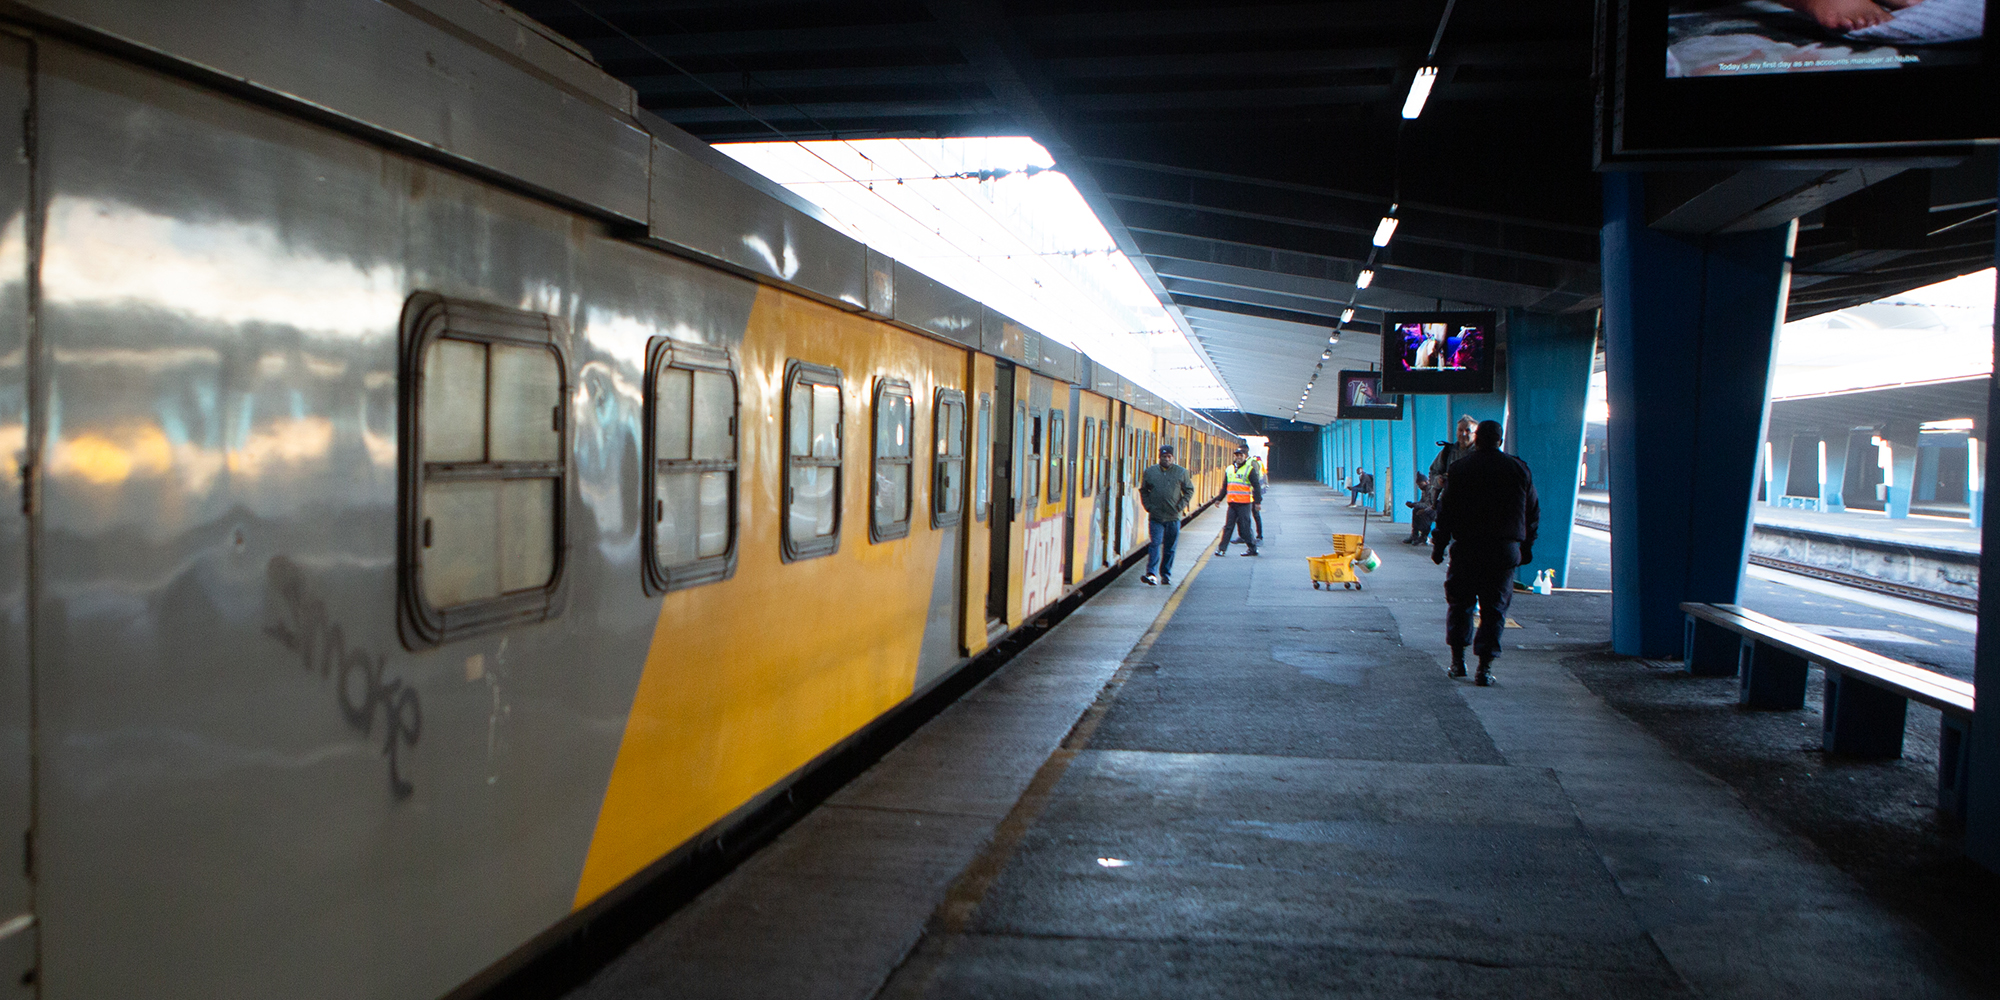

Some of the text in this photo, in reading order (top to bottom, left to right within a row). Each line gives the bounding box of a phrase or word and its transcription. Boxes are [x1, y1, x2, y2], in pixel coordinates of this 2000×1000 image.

[1718, 63, 1740, 71] Today
[1749, 63, 1761, 71] my
[1762, 61, 1777, 69] first
[1777, 61, 1792, 69] day
[1850, 57, 1884, 65] manager
